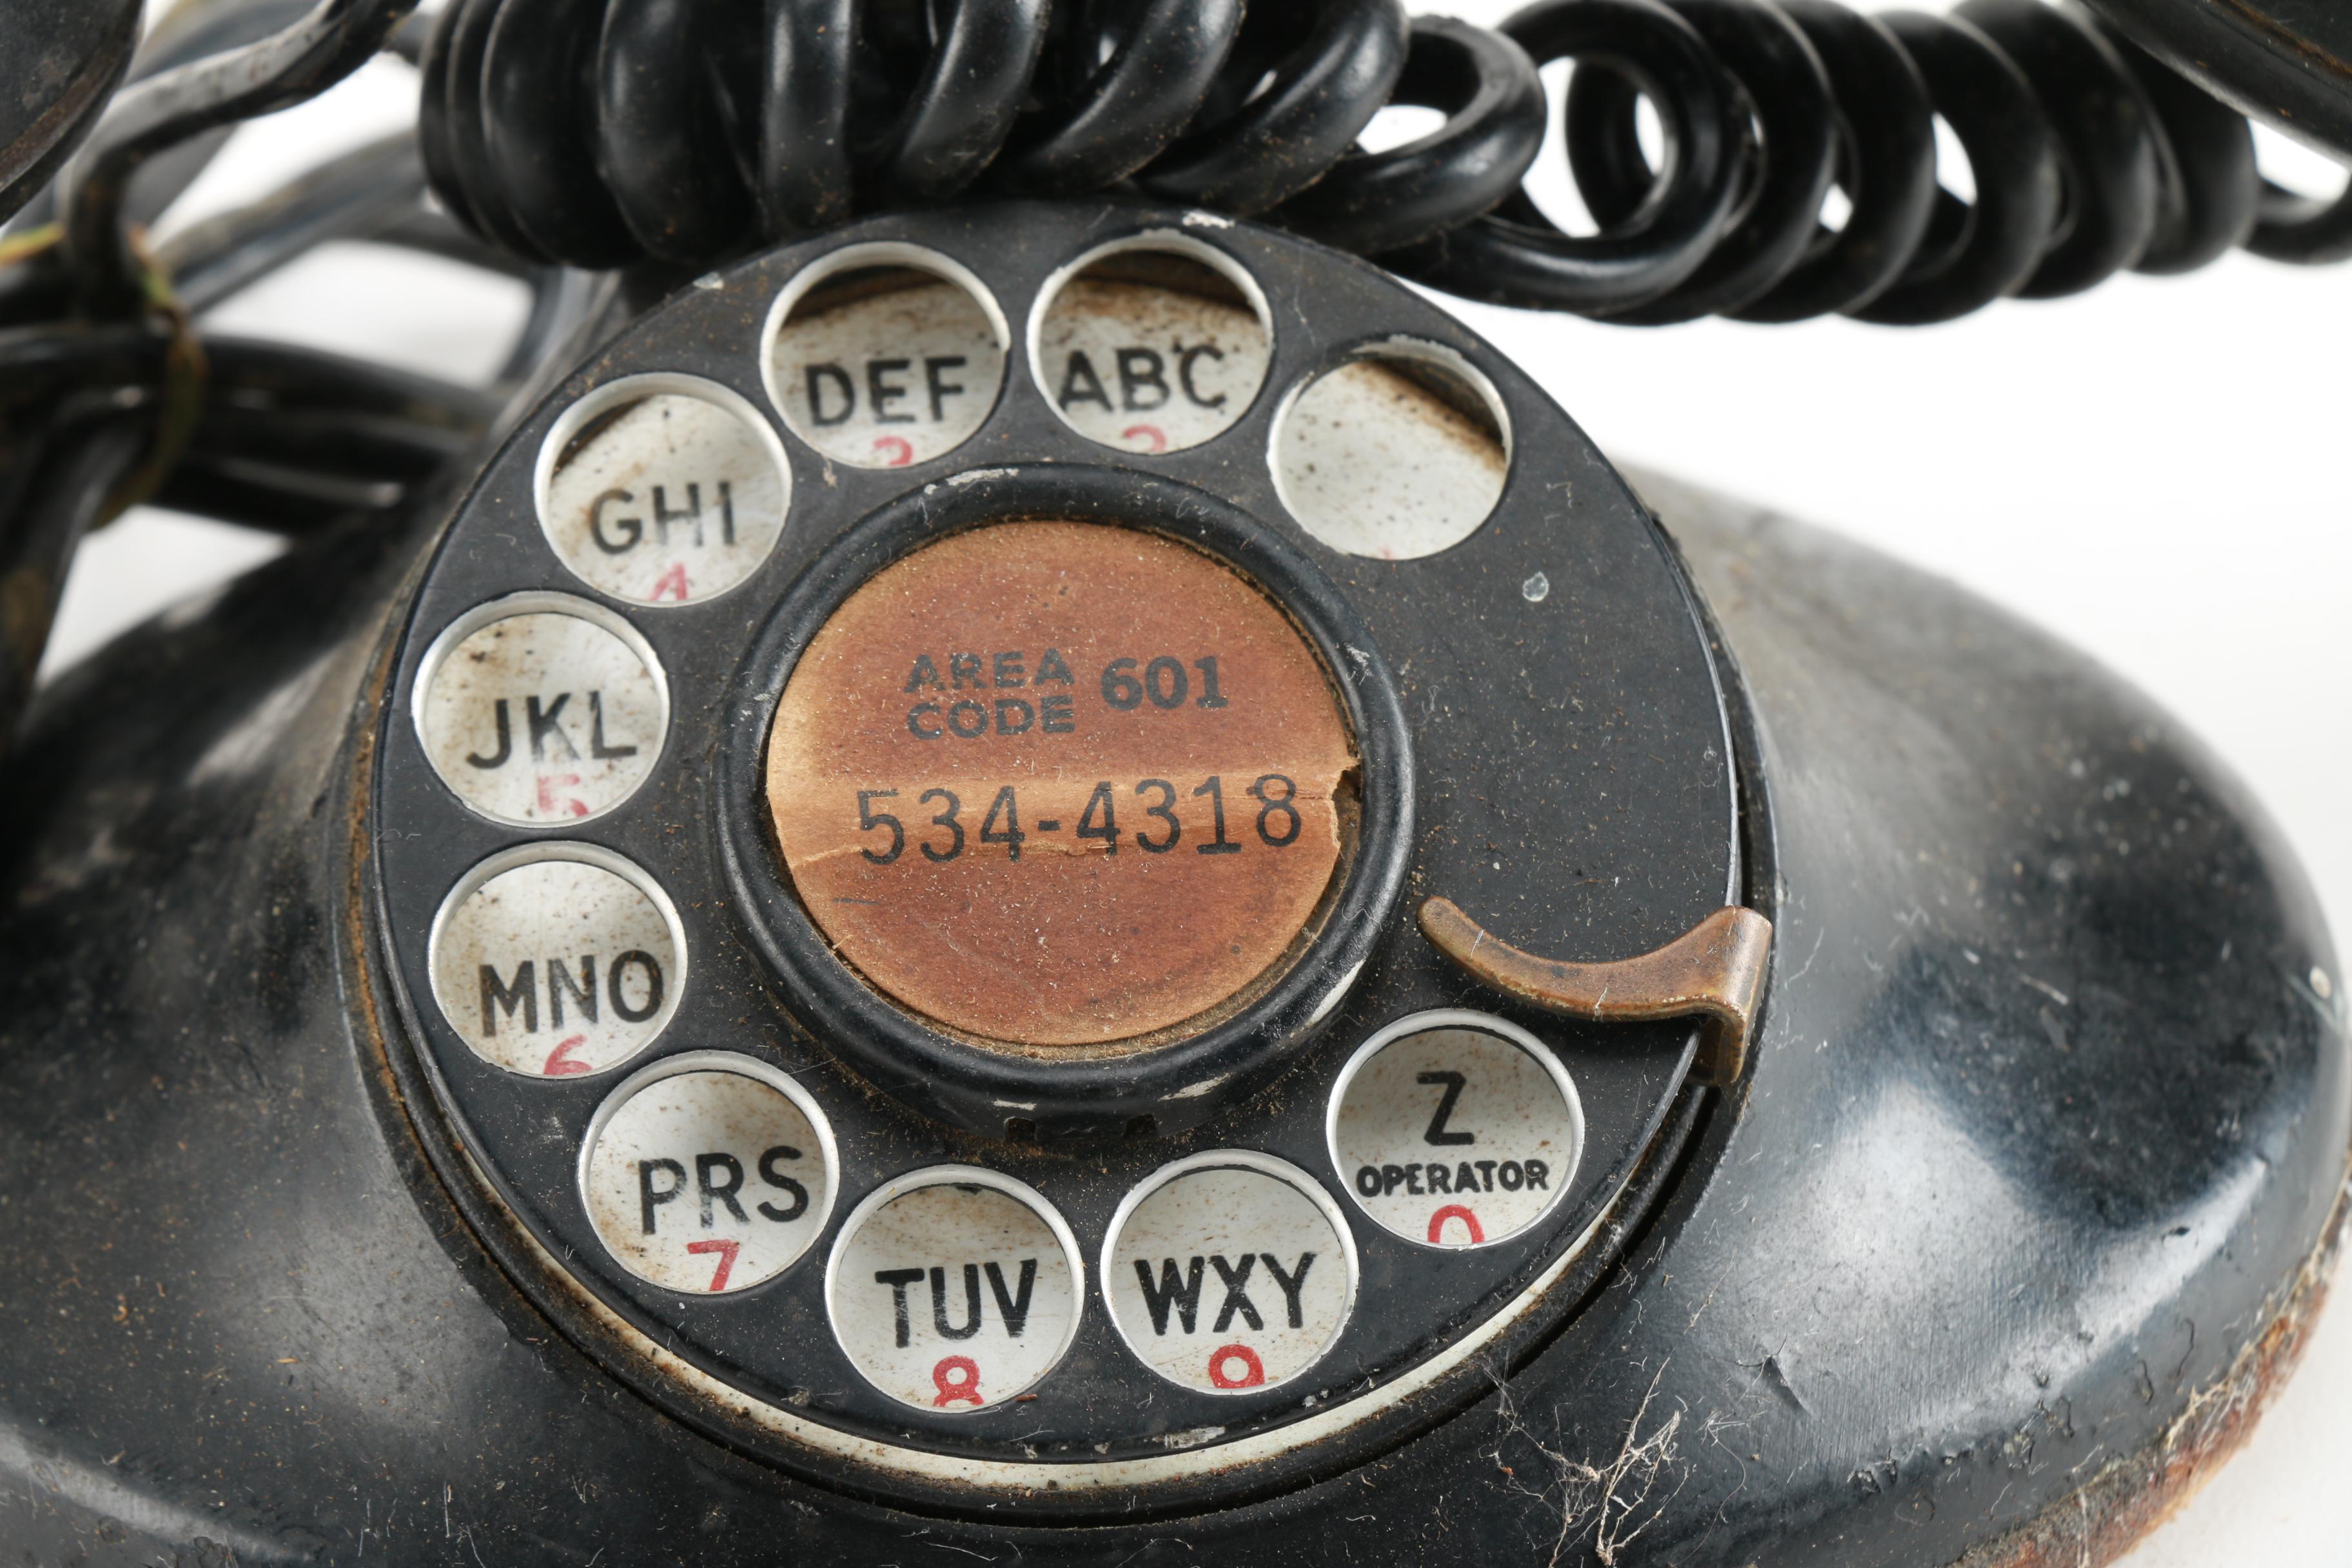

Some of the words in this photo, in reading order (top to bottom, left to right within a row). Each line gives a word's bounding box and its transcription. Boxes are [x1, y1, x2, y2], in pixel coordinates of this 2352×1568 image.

[803, 353, 968, 428] DEF
[1056, 344, 1228, 416] ABC
[586, 480, 736, 556] GHI
[903, 647, 1075, 695] AREA
[1100, 655, 1228, 711] 601
[466, 690, 638, 769] JKL
[904, 694, 1075, 740] CODE
[857, 774, 1302, 865] 534-4318
[478, 950, 665, 1038] MNO
[1416, 1070, 1475, 1146] Z
[638, 1145, 809, 1235] PRS
[1356, 1159, 1549, 1199] OPERATOR
[687, 1239, 740, 1291] 7
[875, 1257, 1038, 1349] TUV
[1133, 1252, 1317, 1337] WXY
